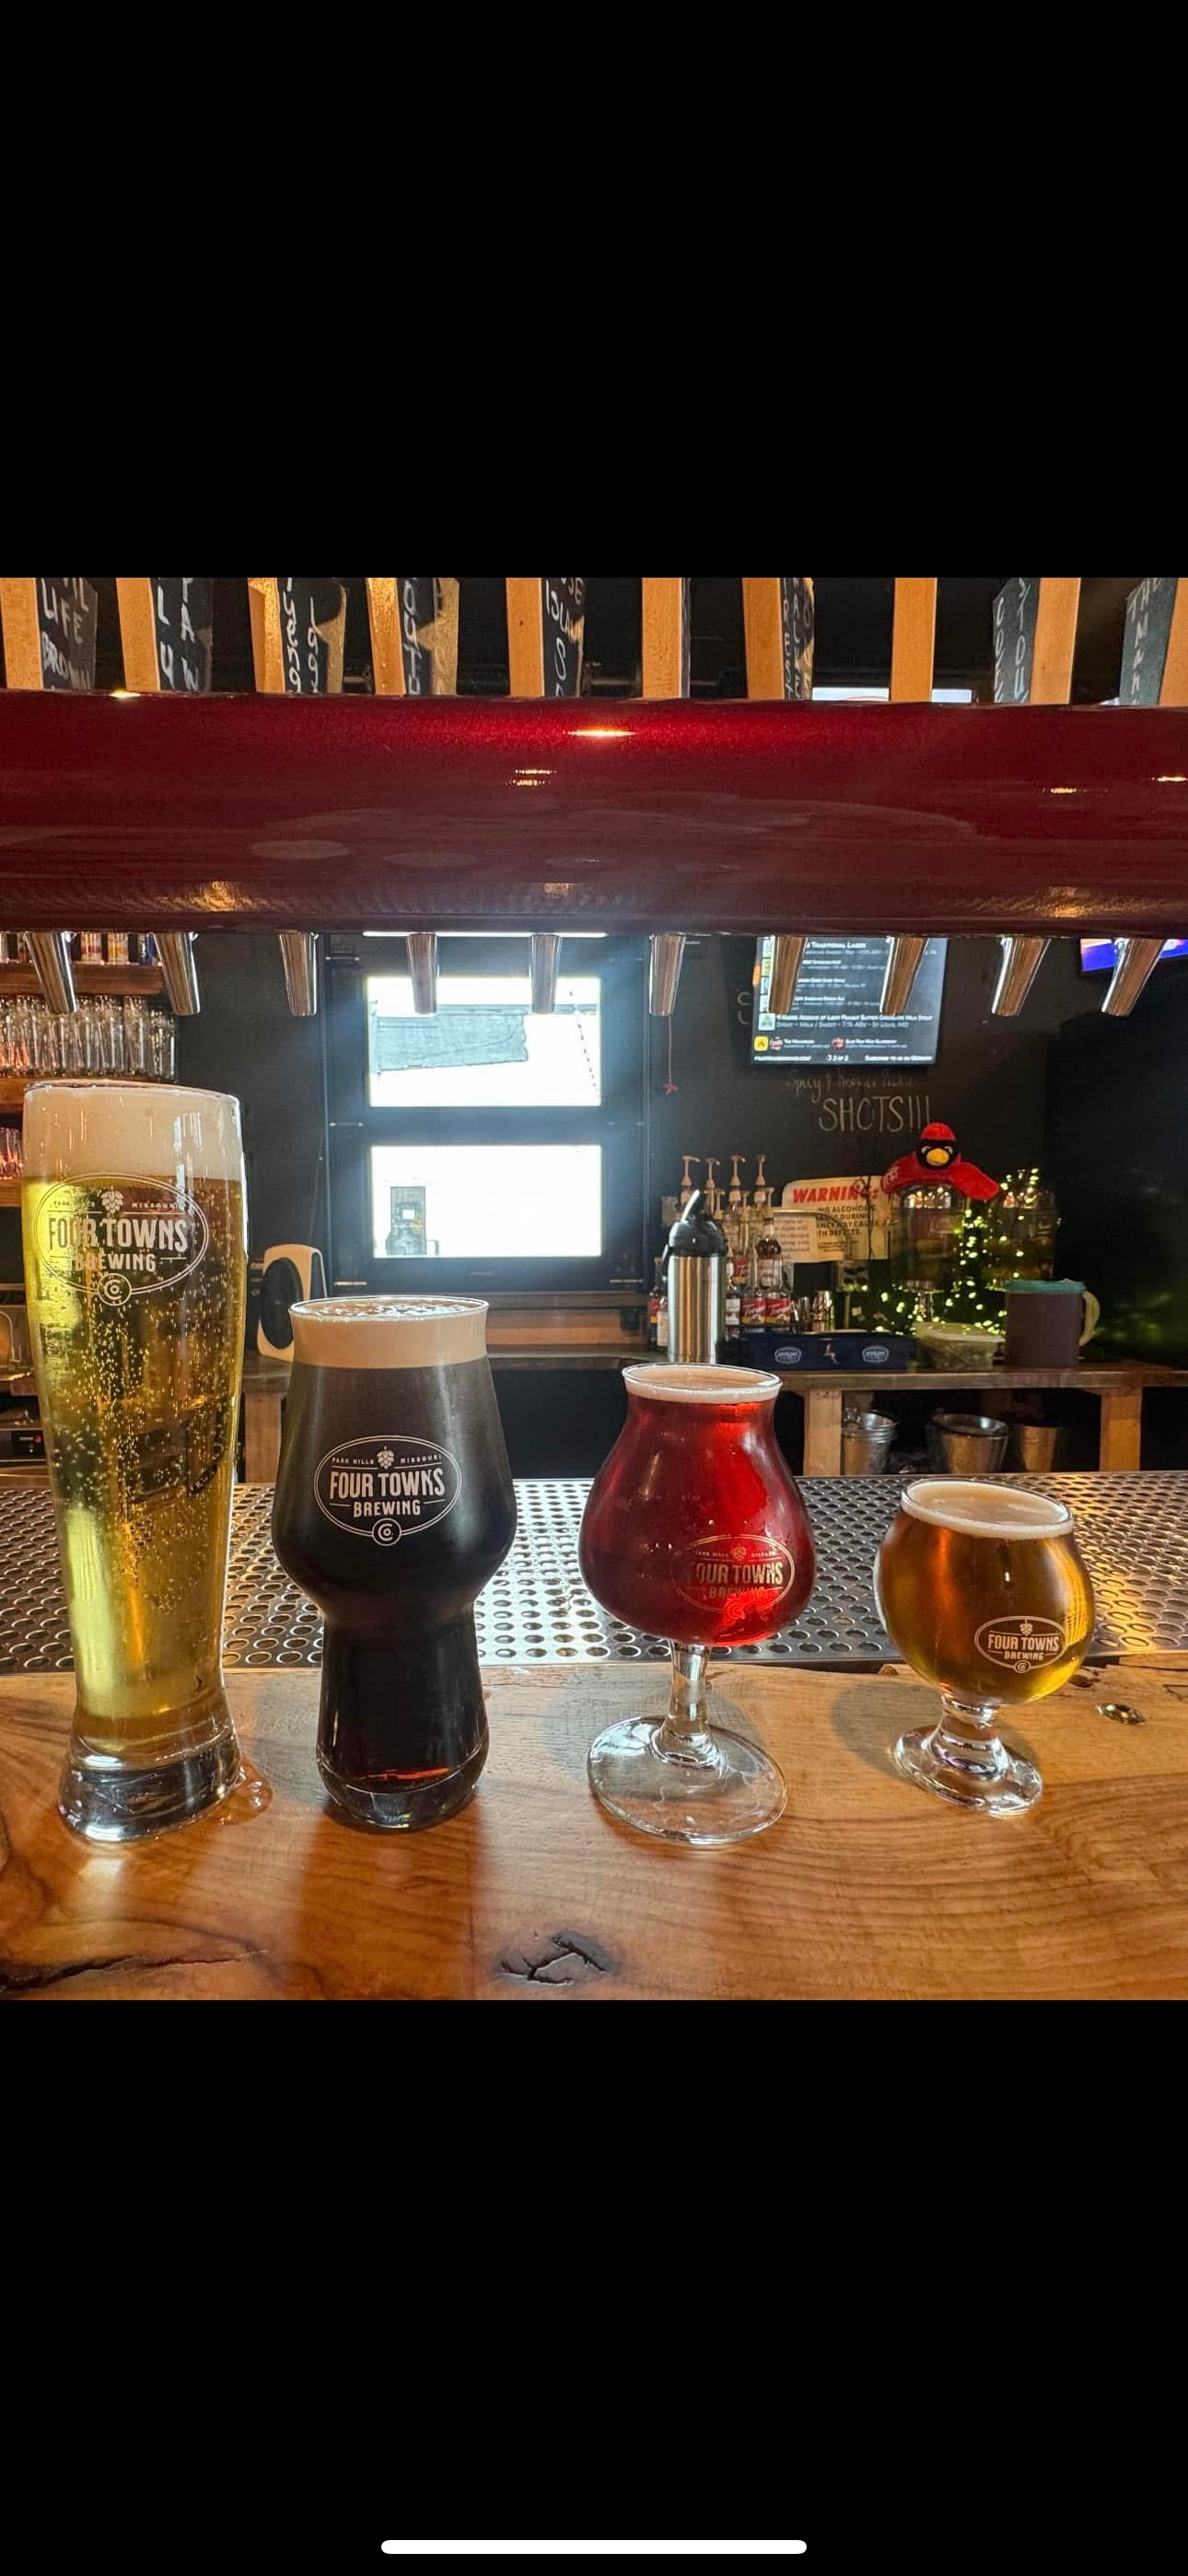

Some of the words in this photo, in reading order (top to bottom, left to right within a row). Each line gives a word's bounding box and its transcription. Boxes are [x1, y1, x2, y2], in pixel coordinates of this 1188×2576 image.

[49, 1217, 99, 1250] FOUR
[99, 1218, 189, 1253] TOWNS
[74, 1253, 157, 1271] BREWING
[401, 1454, 442, 1464] MISSOURI
[330, 1470, 373, 1500] FOUR
[378, 1468, 446, 1496] TOWNS
[353, 1499, 421, 1518] BREWING
[732, 1562, 784, 1585] TOWNS
[987, 1633, 1019, 1649] FOUR
[1020, 1635, 1060, 1651] TOWNS
[1004, 1650, 1044, 1660] BREWING
